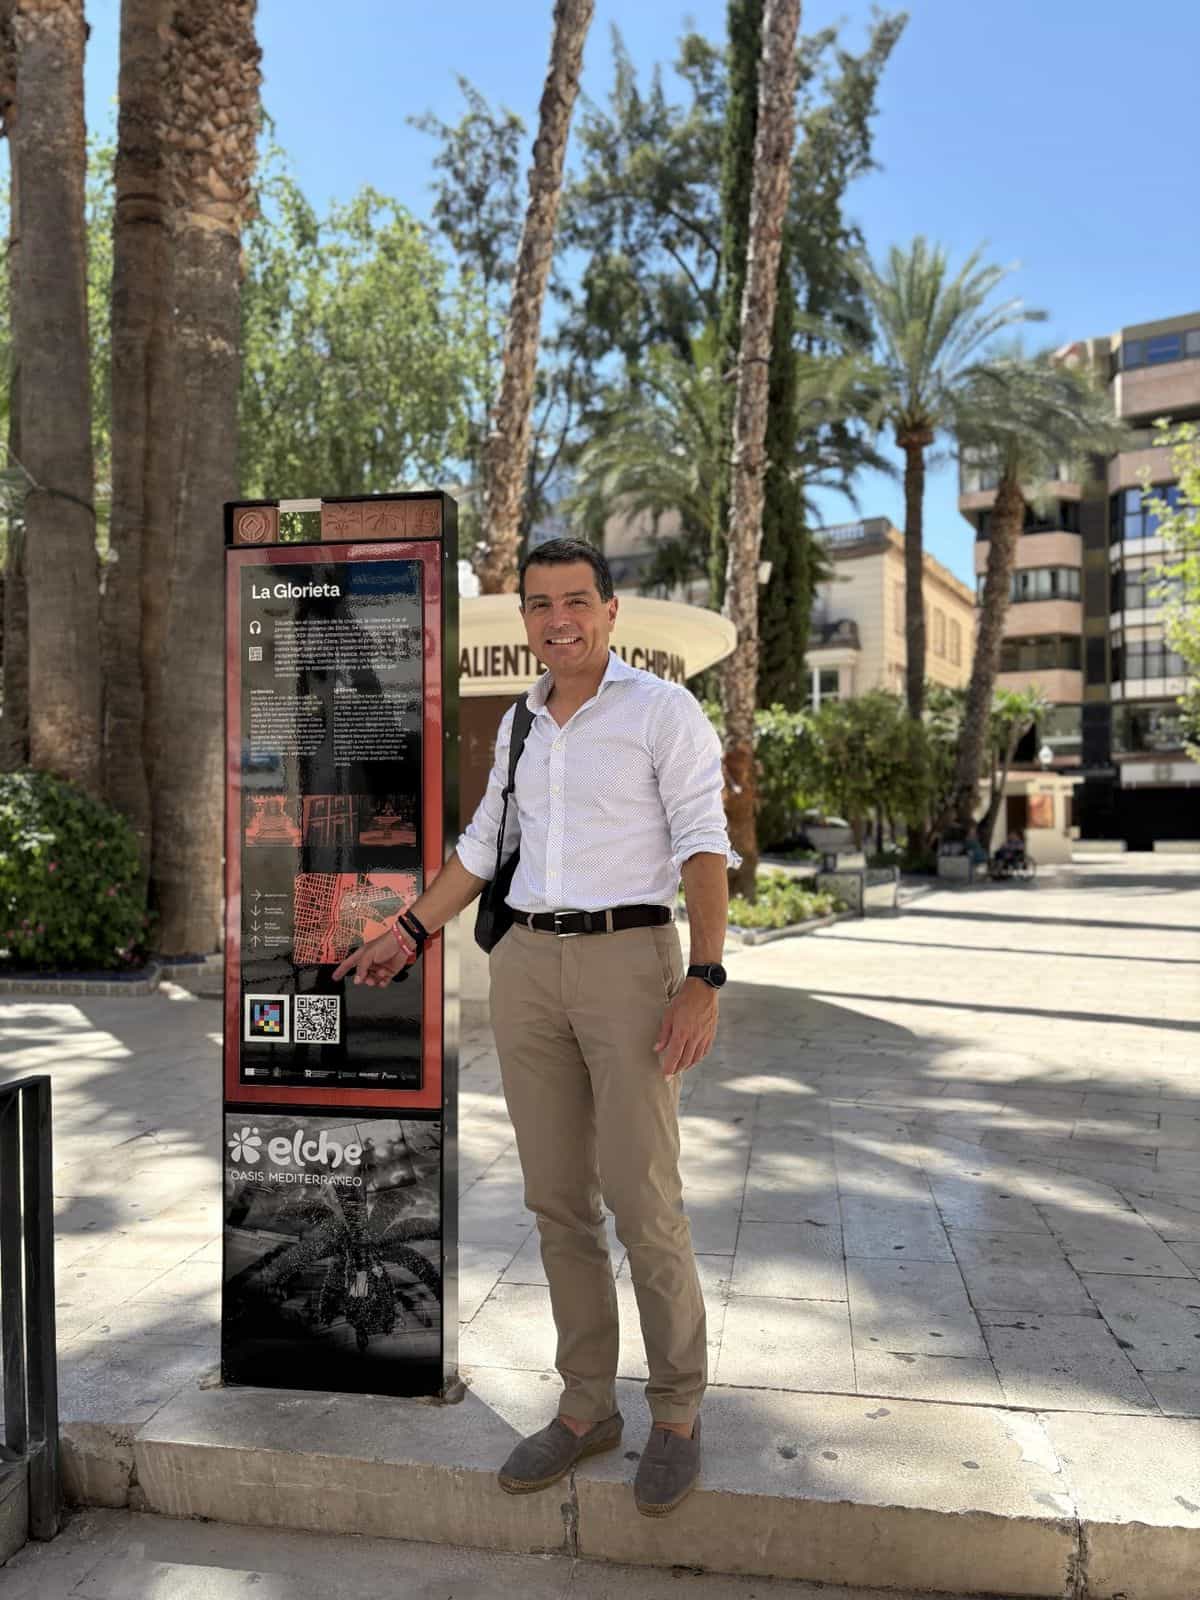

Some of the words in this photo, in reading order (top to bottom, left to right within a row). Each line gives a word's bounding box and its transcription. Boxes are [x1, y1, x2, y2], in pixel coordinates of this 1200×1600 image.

[252, 584, 270, 599] La
[273, 582, 341, 598] Glorieta
[268, 1129, 363, 1168] elche
[231, 1170, 264, 1182] OASIS
